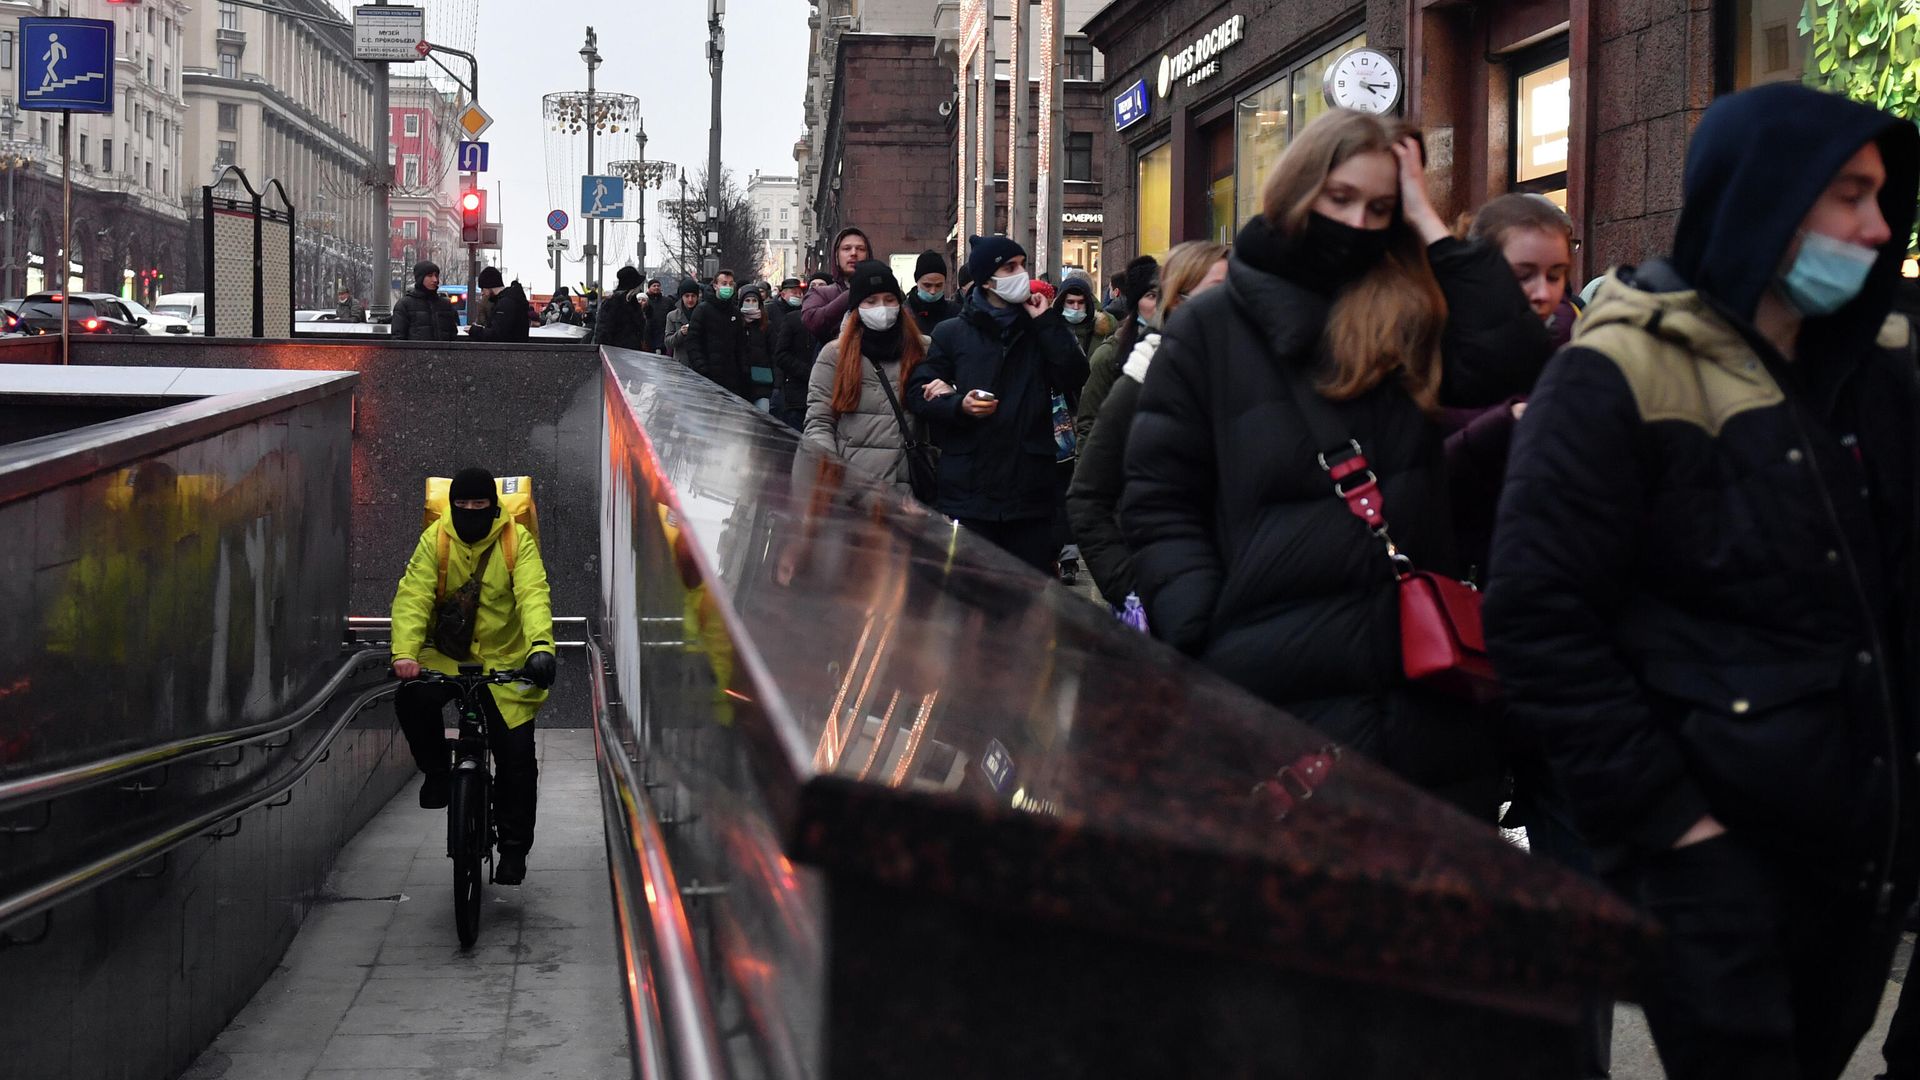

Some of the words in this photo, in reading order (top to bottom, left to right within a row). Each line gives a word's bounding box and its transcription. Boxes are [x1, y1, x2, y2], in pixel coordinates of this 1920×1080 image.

[1170, 45, 1194, 81] YVES
[1195, 14, 1241, 65] ROCHER
[1186, 60, 1218, 87] FRANCE
